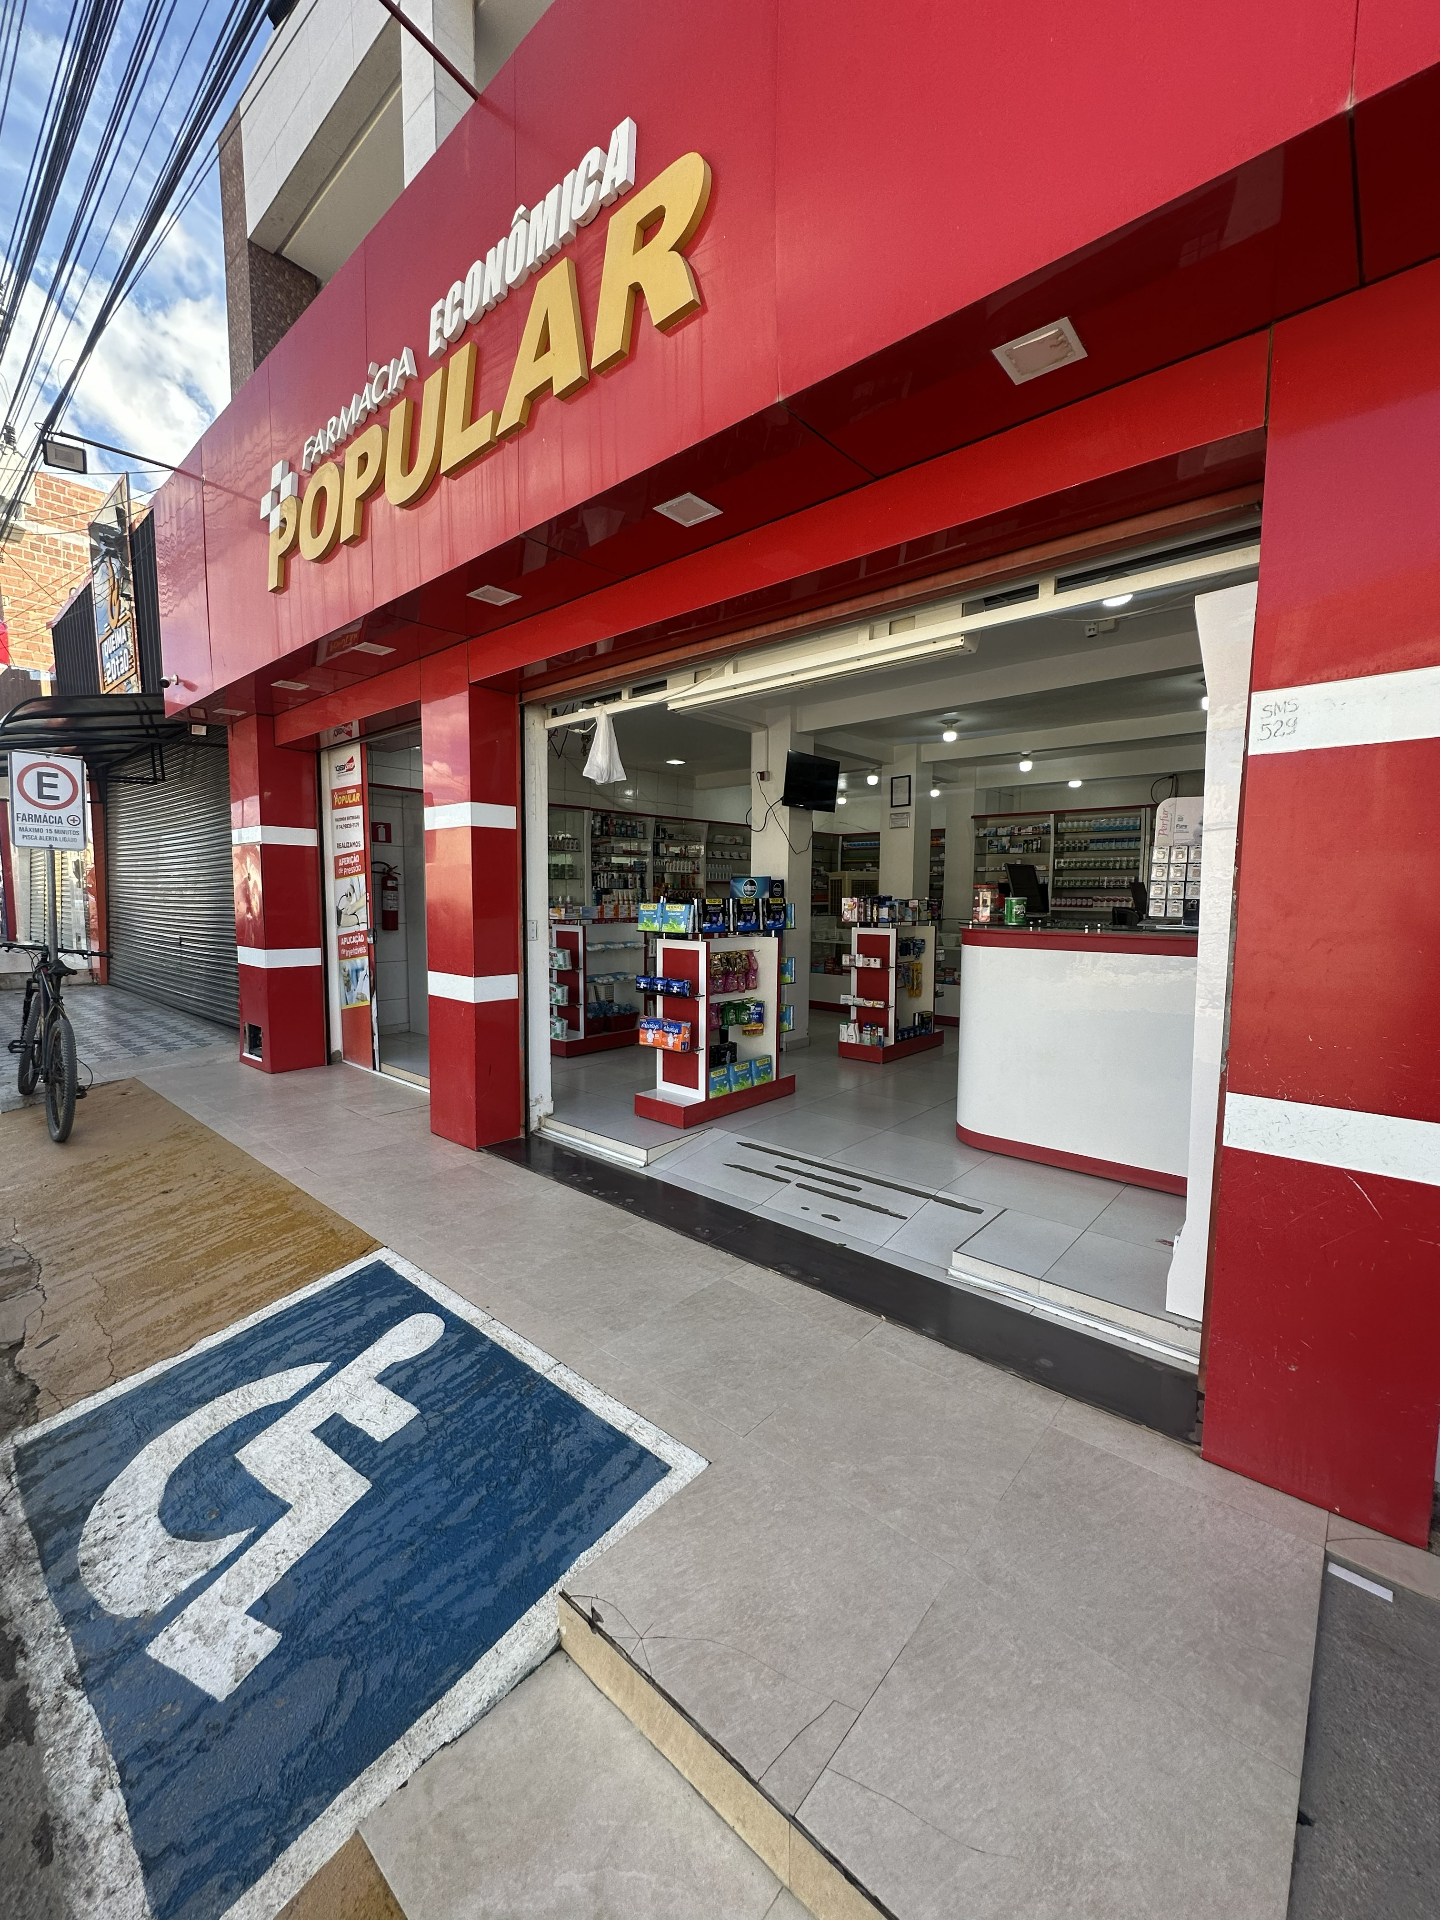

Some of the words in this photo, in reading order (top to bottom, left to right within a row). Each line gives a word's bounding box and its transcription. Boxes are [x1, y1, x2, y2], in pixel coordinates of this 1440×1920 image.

[302, 347, 417, 472] FARMÁCIA
[429, 116, 637, 360] ECONÔMICA
[267, 152, 711, 593] POPULAR
[1261, 698, 1299, 719] SMS
[1257, 717, 1298, 741] 529
[37, 771, 60, 800] E
[334, 792, 360, 806] POPULAR
[16, 812, 63, 825] FARMÁCIA
[19, 826, 43, 834] MÁXIMO
[336, 840, 361, 849] REALIZAMOS
[338, 853, 360, 867] AFERIÇÃO
[340, 932, 365, 946] APLICAÇÃO
